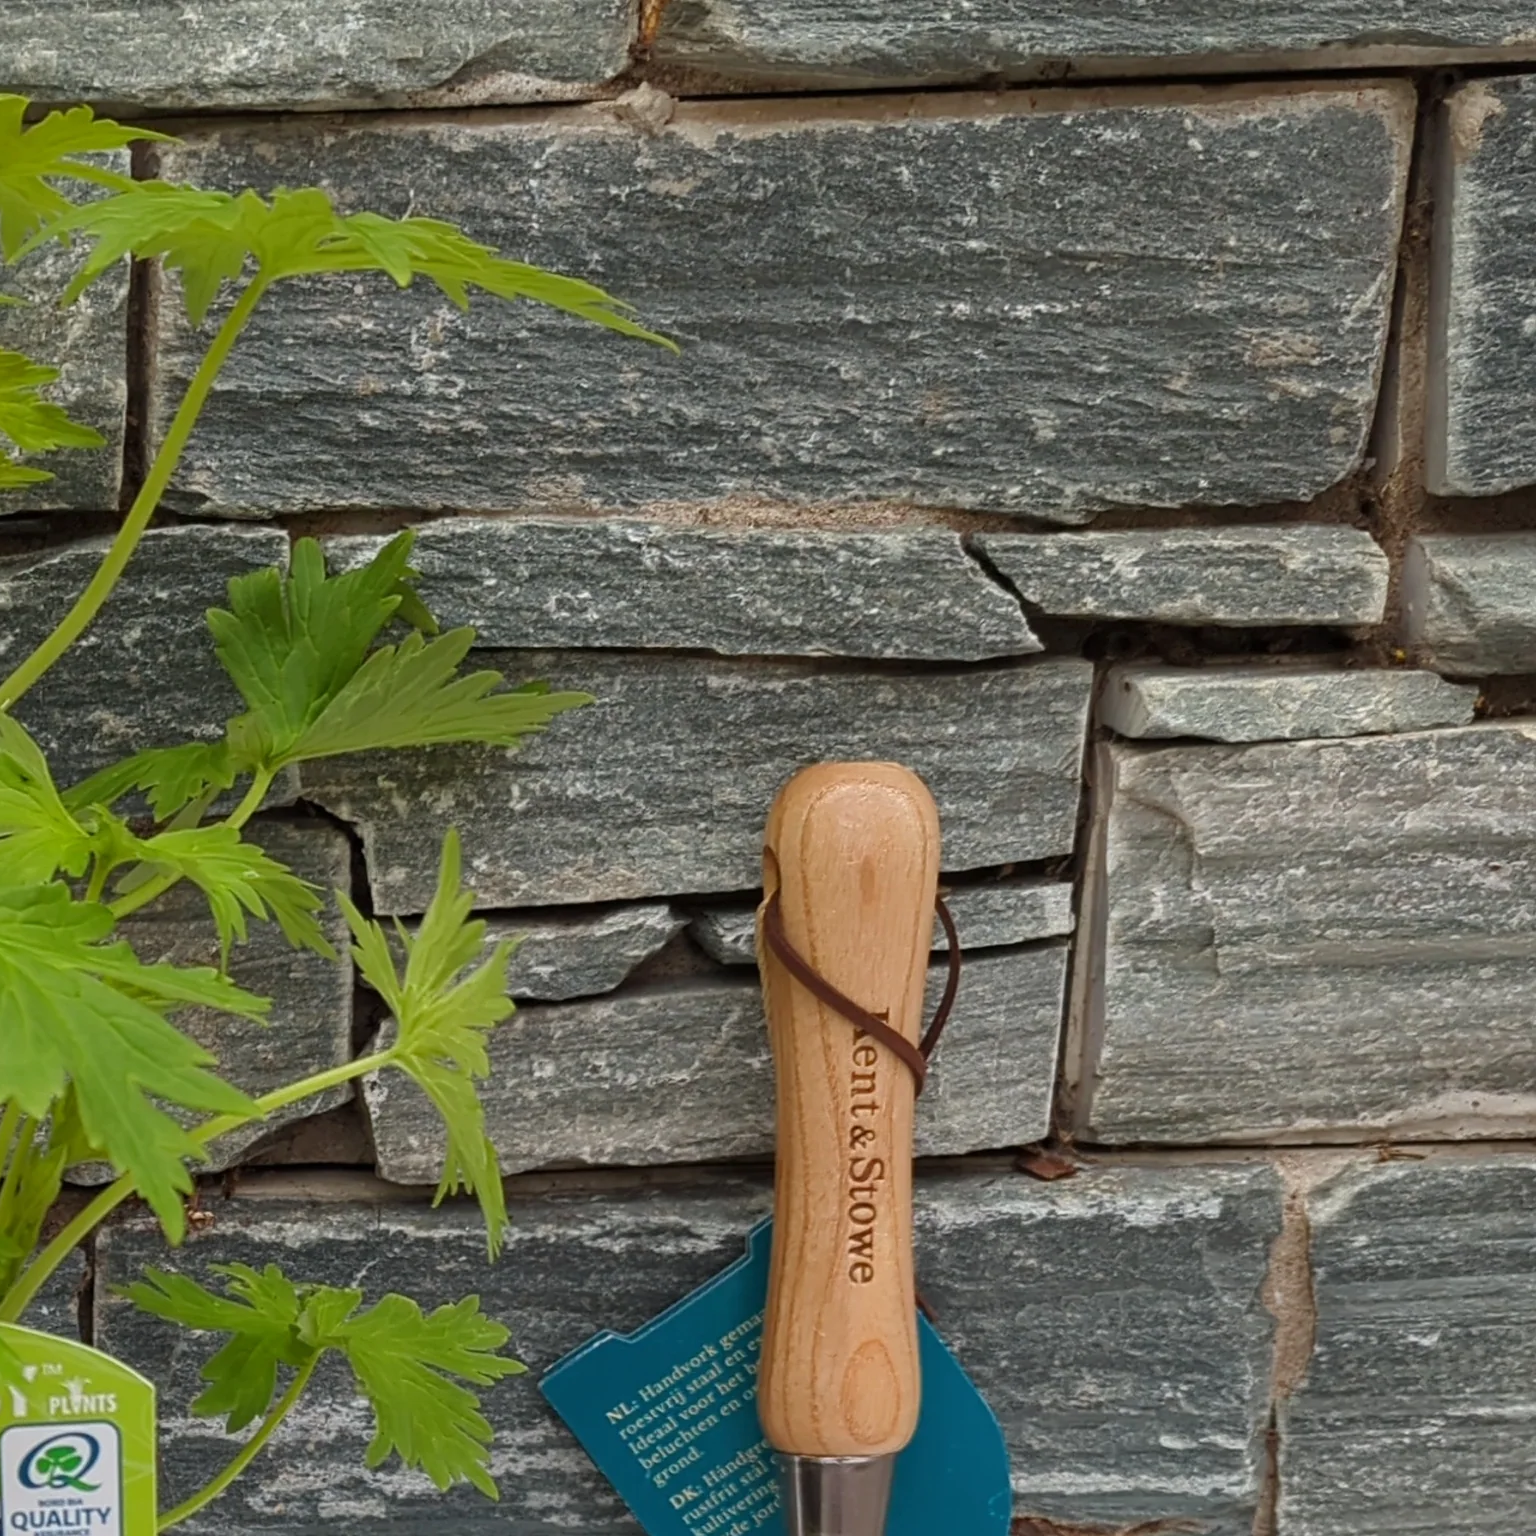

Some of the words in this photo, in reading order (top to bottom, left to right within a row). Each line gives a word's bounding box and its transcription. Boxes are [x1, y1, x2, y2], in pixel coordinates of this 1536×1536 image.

[605, 1400, 641, 1425] NL:
[638, 1344, 719, 1402] Handvork
[618, 1389, 688, 1441] roestvrij
[685, 1362, 724, 1395] staal
[724, 1349, 747, 1368] en
[628, 1417, 679, 1455] Ideaal
[678, 1392, 716, 1421] voor
[714, 1373, 746, 1396] het
[638, 1413, 720, 1470] beluchten
[719, 1398, 742, 1418] en
[652, 1445, 706, 1488] grond.
[10, 1507, 112, 1532] QUALITY
[668, 1482, 704, 1510] DK:
[681, 1484, 740, 1525] rustfrit
